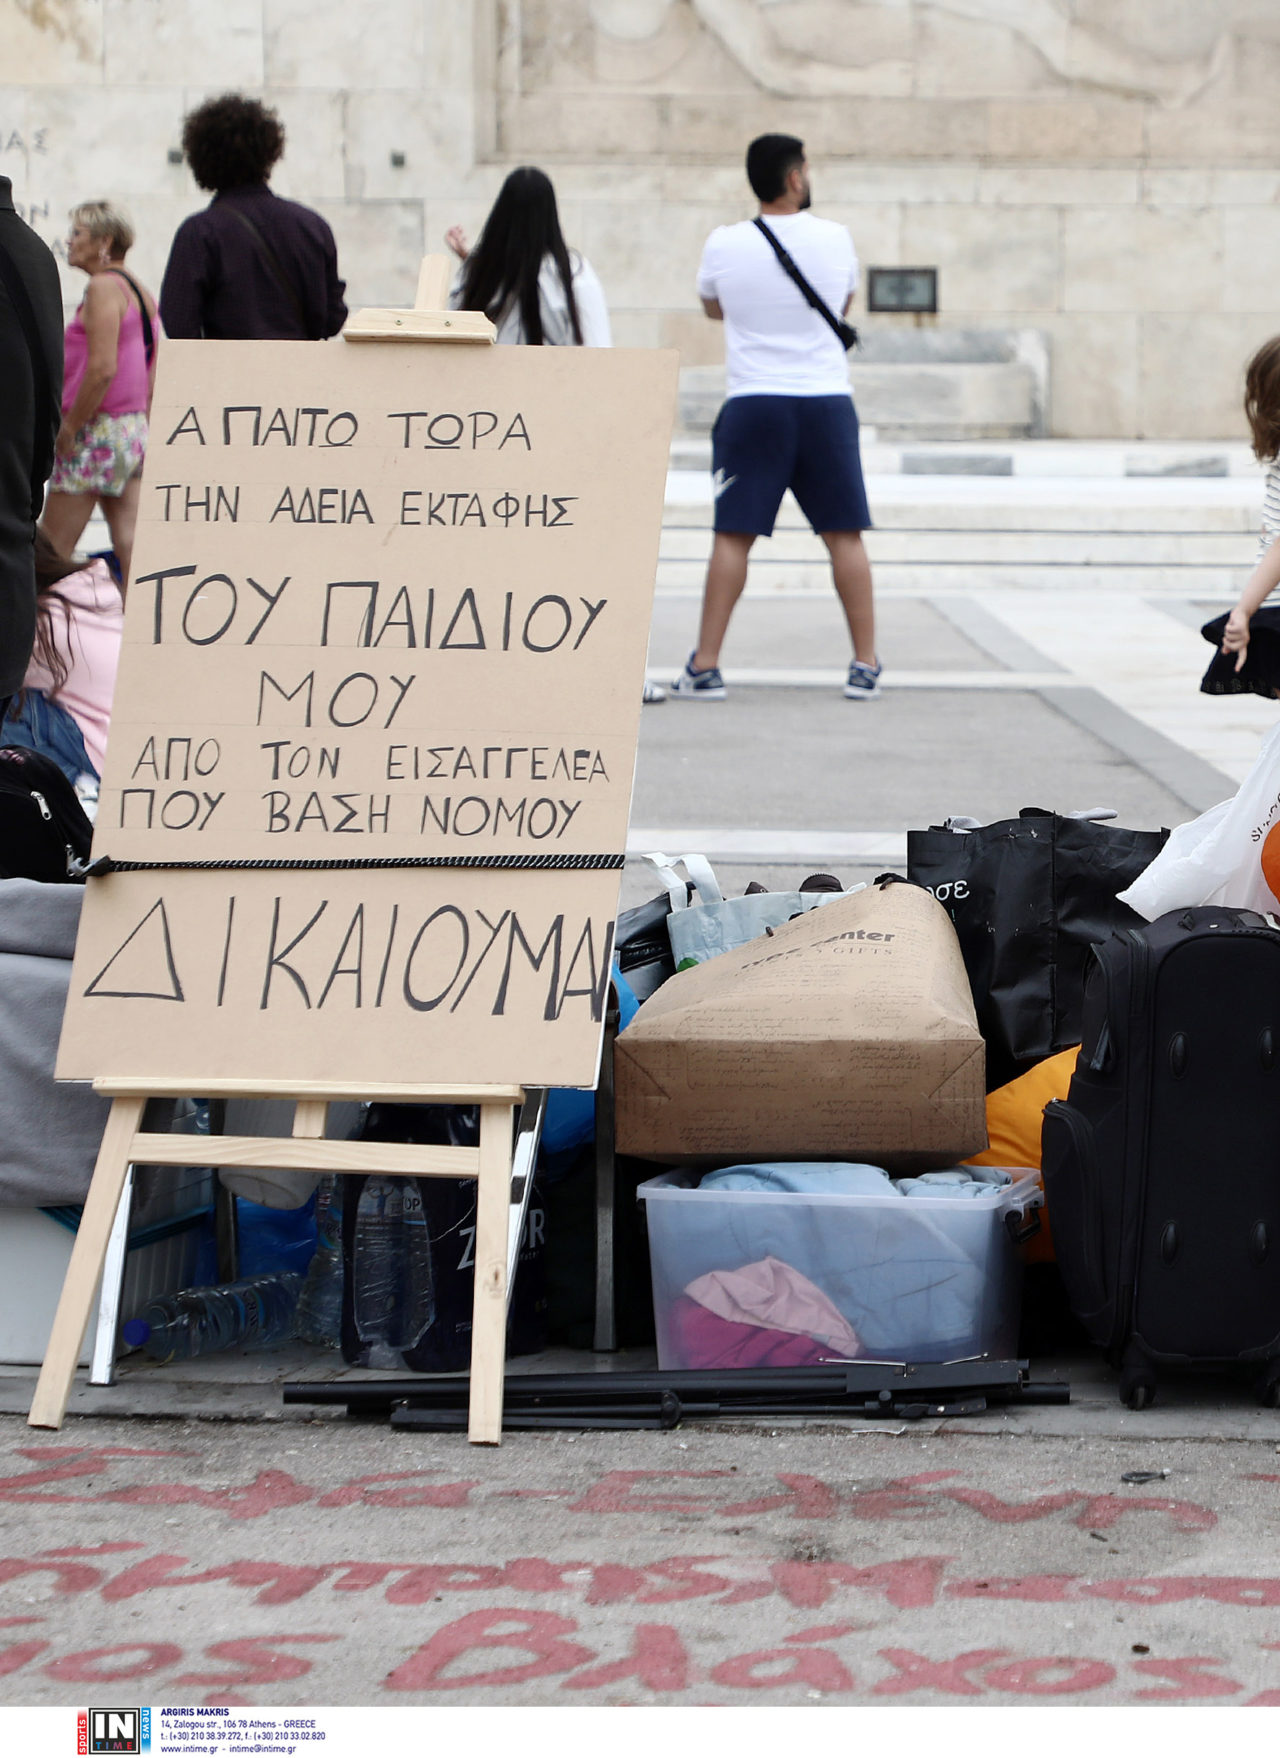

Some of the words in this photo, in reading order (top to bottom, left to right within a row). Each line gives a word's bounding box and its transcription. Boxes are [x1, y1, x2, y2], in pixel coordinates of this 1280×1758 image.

[155, 483, 240, 523] ΤΗΝ
[270, 486, 375, 525] ΑΔΕΙΑ
[400, 490, 579, 528] ΕΚΤΑΦΗΣ
[134, 564, 292, 646] ΤΟΥ
[320, 580, 608, 653] ΠΑΙΔΙΟΥ
[257, 670, 416, 729] ΜΟΥ
[131, 735, 220, 781] ΑΠΟ
[260, 740, 340, 781] ΤΟΝ
[386, 745, 610, 784] ΕΙΣΑΓΓΕΛΕΑ
[119, 788, 226, 831] ΠΟΥ
[261, 789, 391, 834] ΒΑΣΗ
[420, 795, 582, 840] ΝΟΜΟΥ
